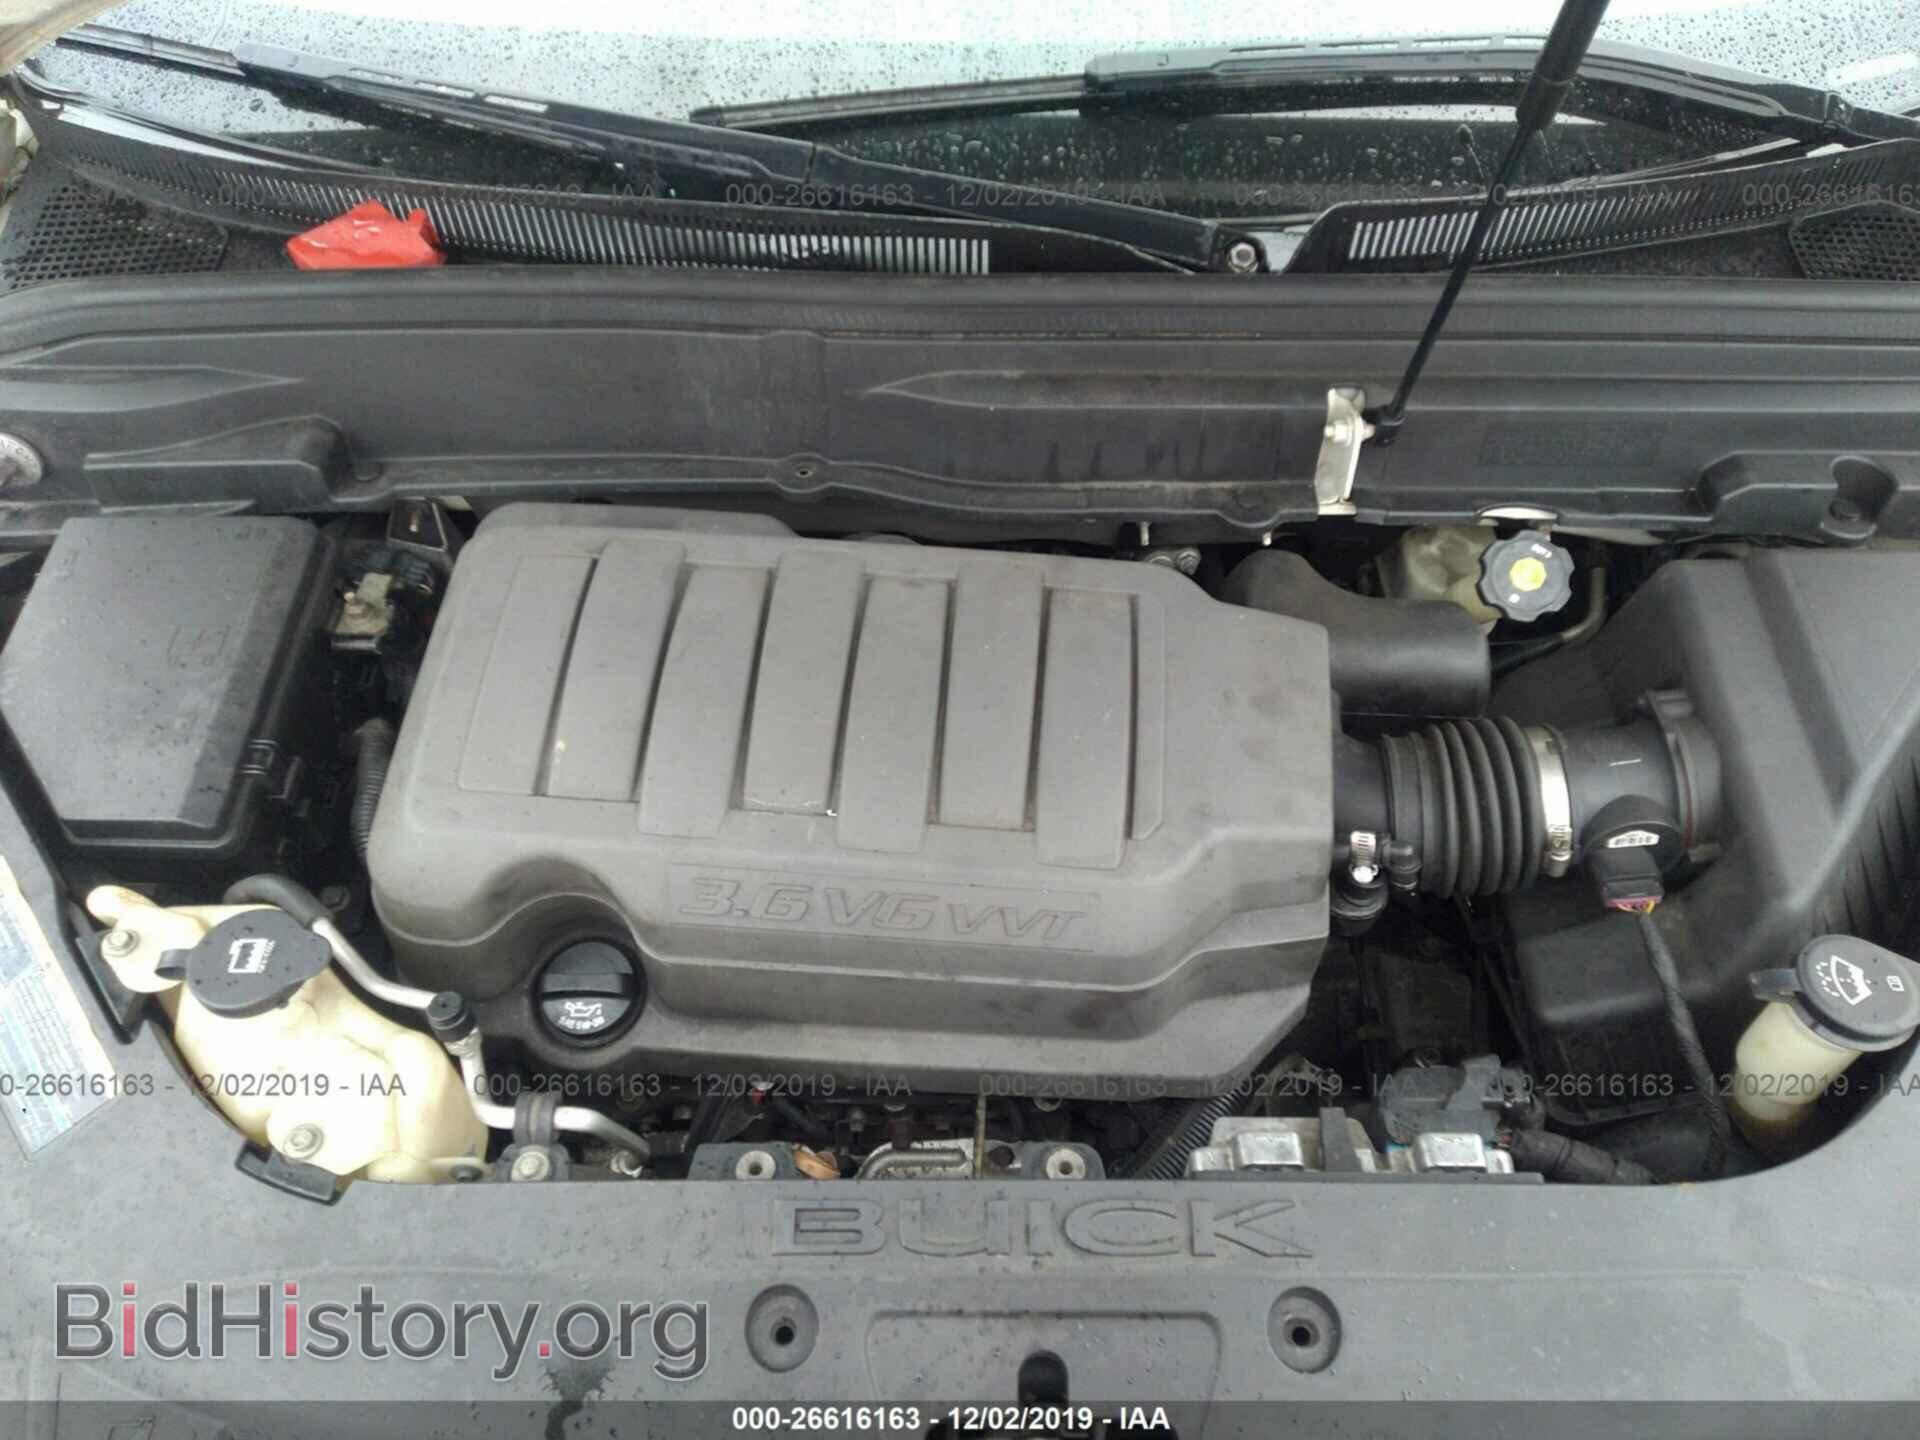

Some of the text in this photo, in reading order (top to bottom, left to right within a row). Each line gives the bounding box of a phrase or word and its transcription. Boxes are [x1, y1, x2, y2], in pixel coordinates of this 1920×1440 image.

[679, 877, 812, 922] 3.6
[946, 902, 1086, 942] VVT
[772, 1199, 1312, 1258] BUICK
